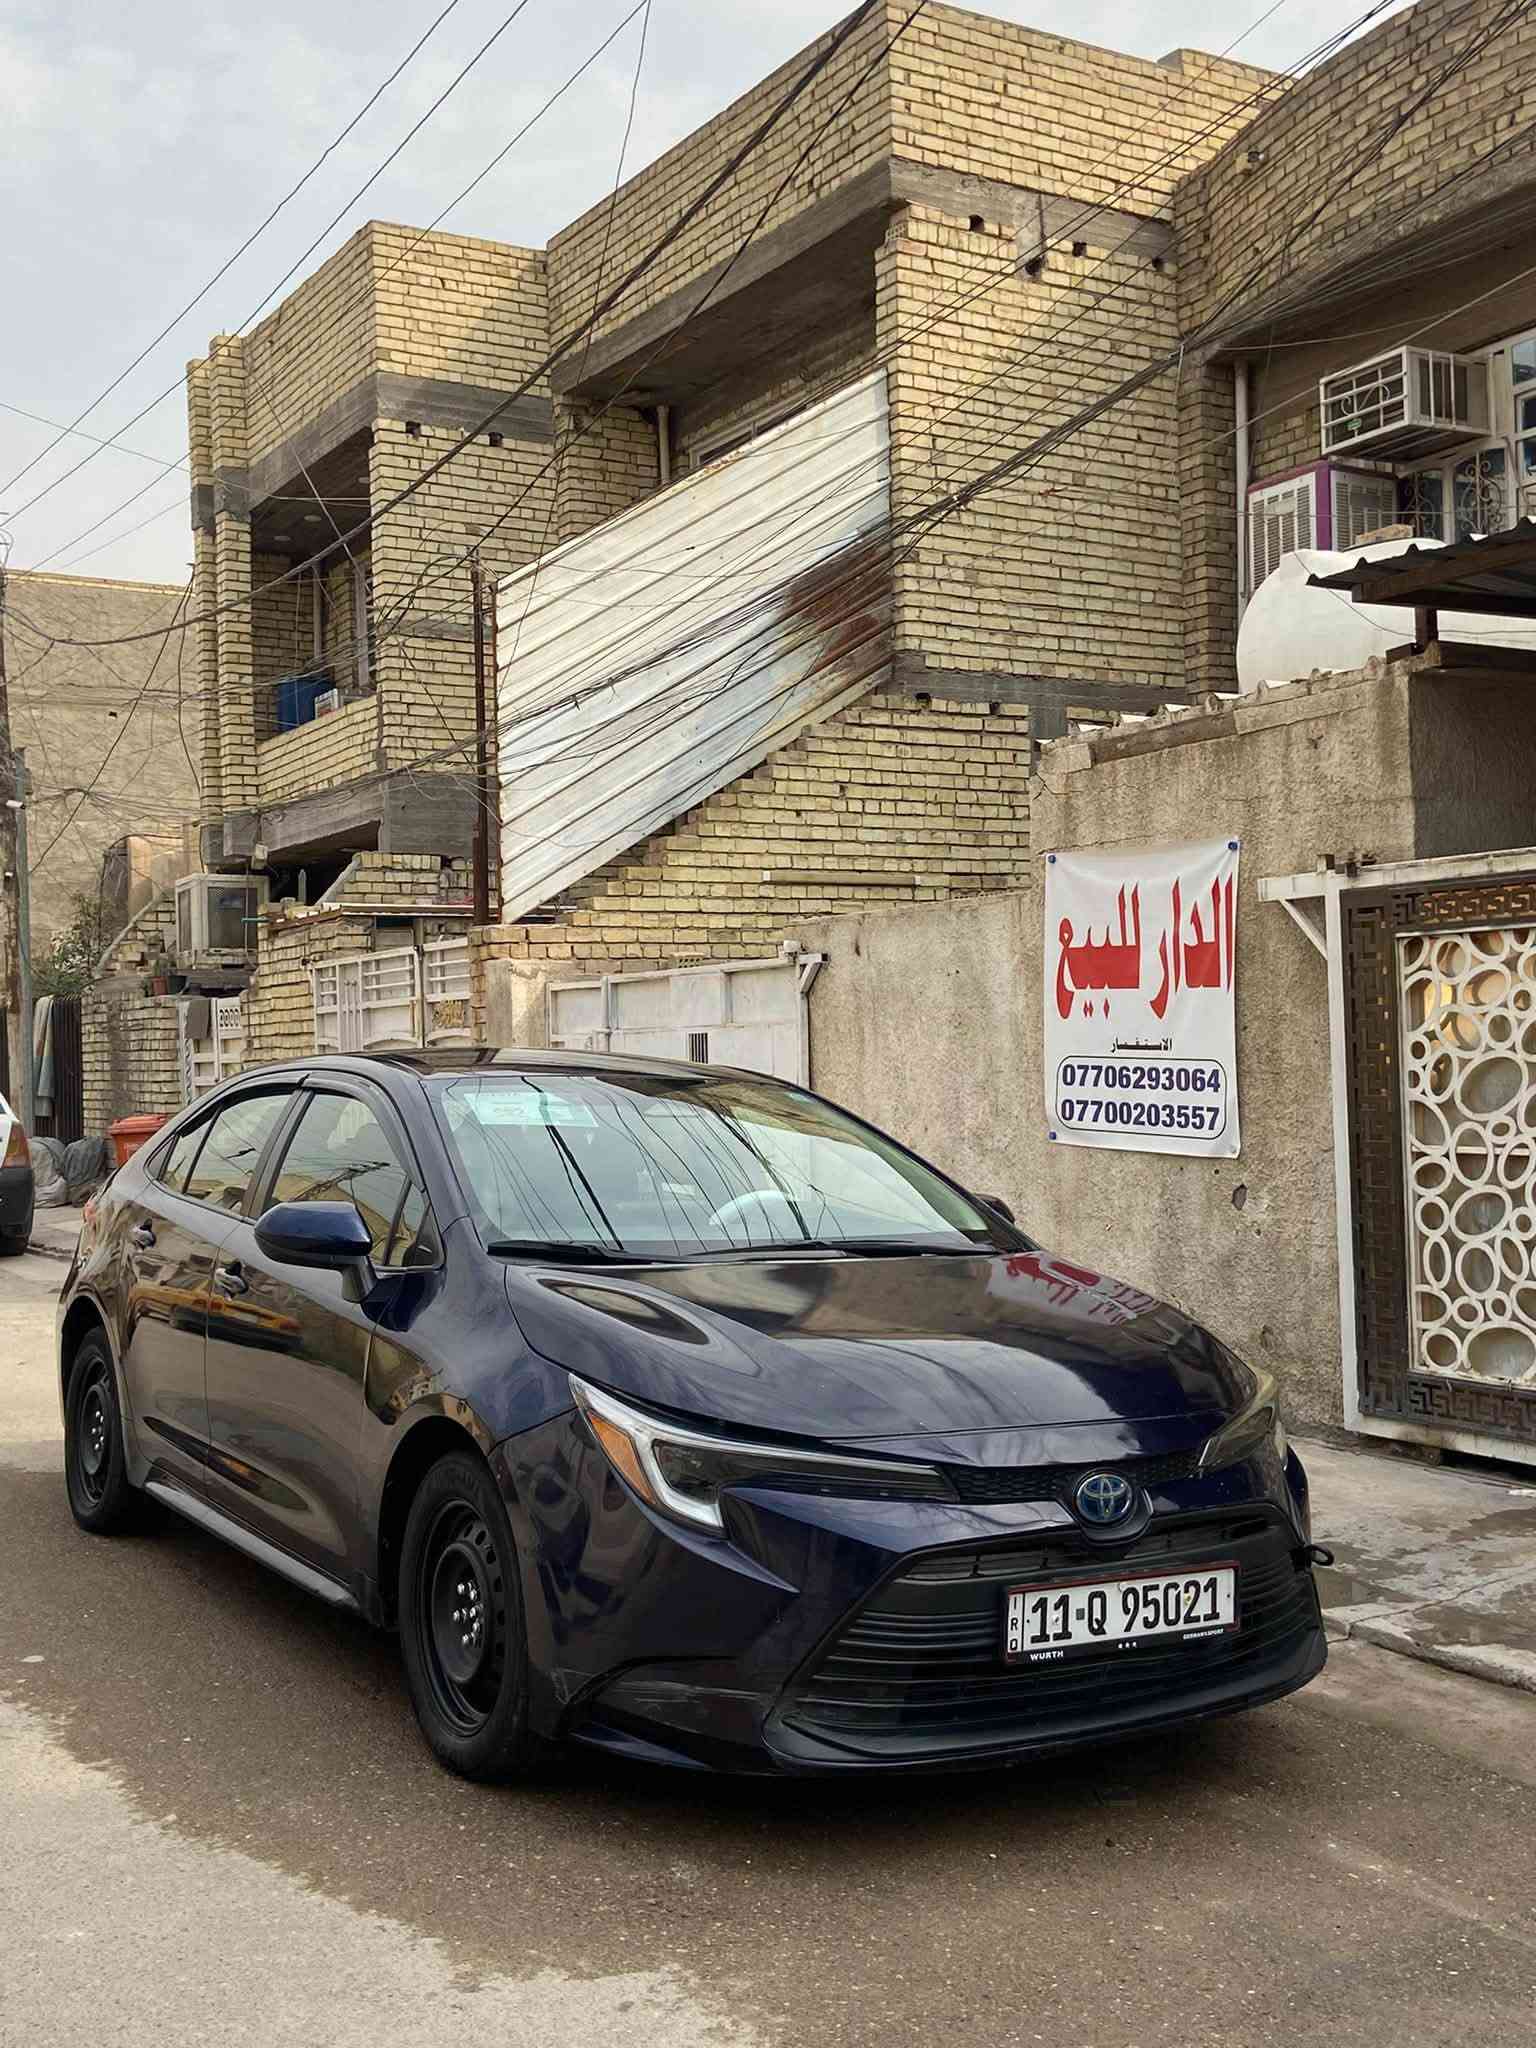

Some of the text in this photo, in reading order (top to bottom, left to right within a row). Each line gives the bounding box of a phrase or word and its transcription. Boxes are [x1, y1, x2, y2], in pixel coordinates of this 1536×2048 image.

[1056, 872, 1233, 1019] الدار للبيع
[1062, 1064, 1221, 1093] 07706293064
[1061, 1099, 1220, 1131] 07700203557
[1121, 1576, 1220, 1633] 95021
